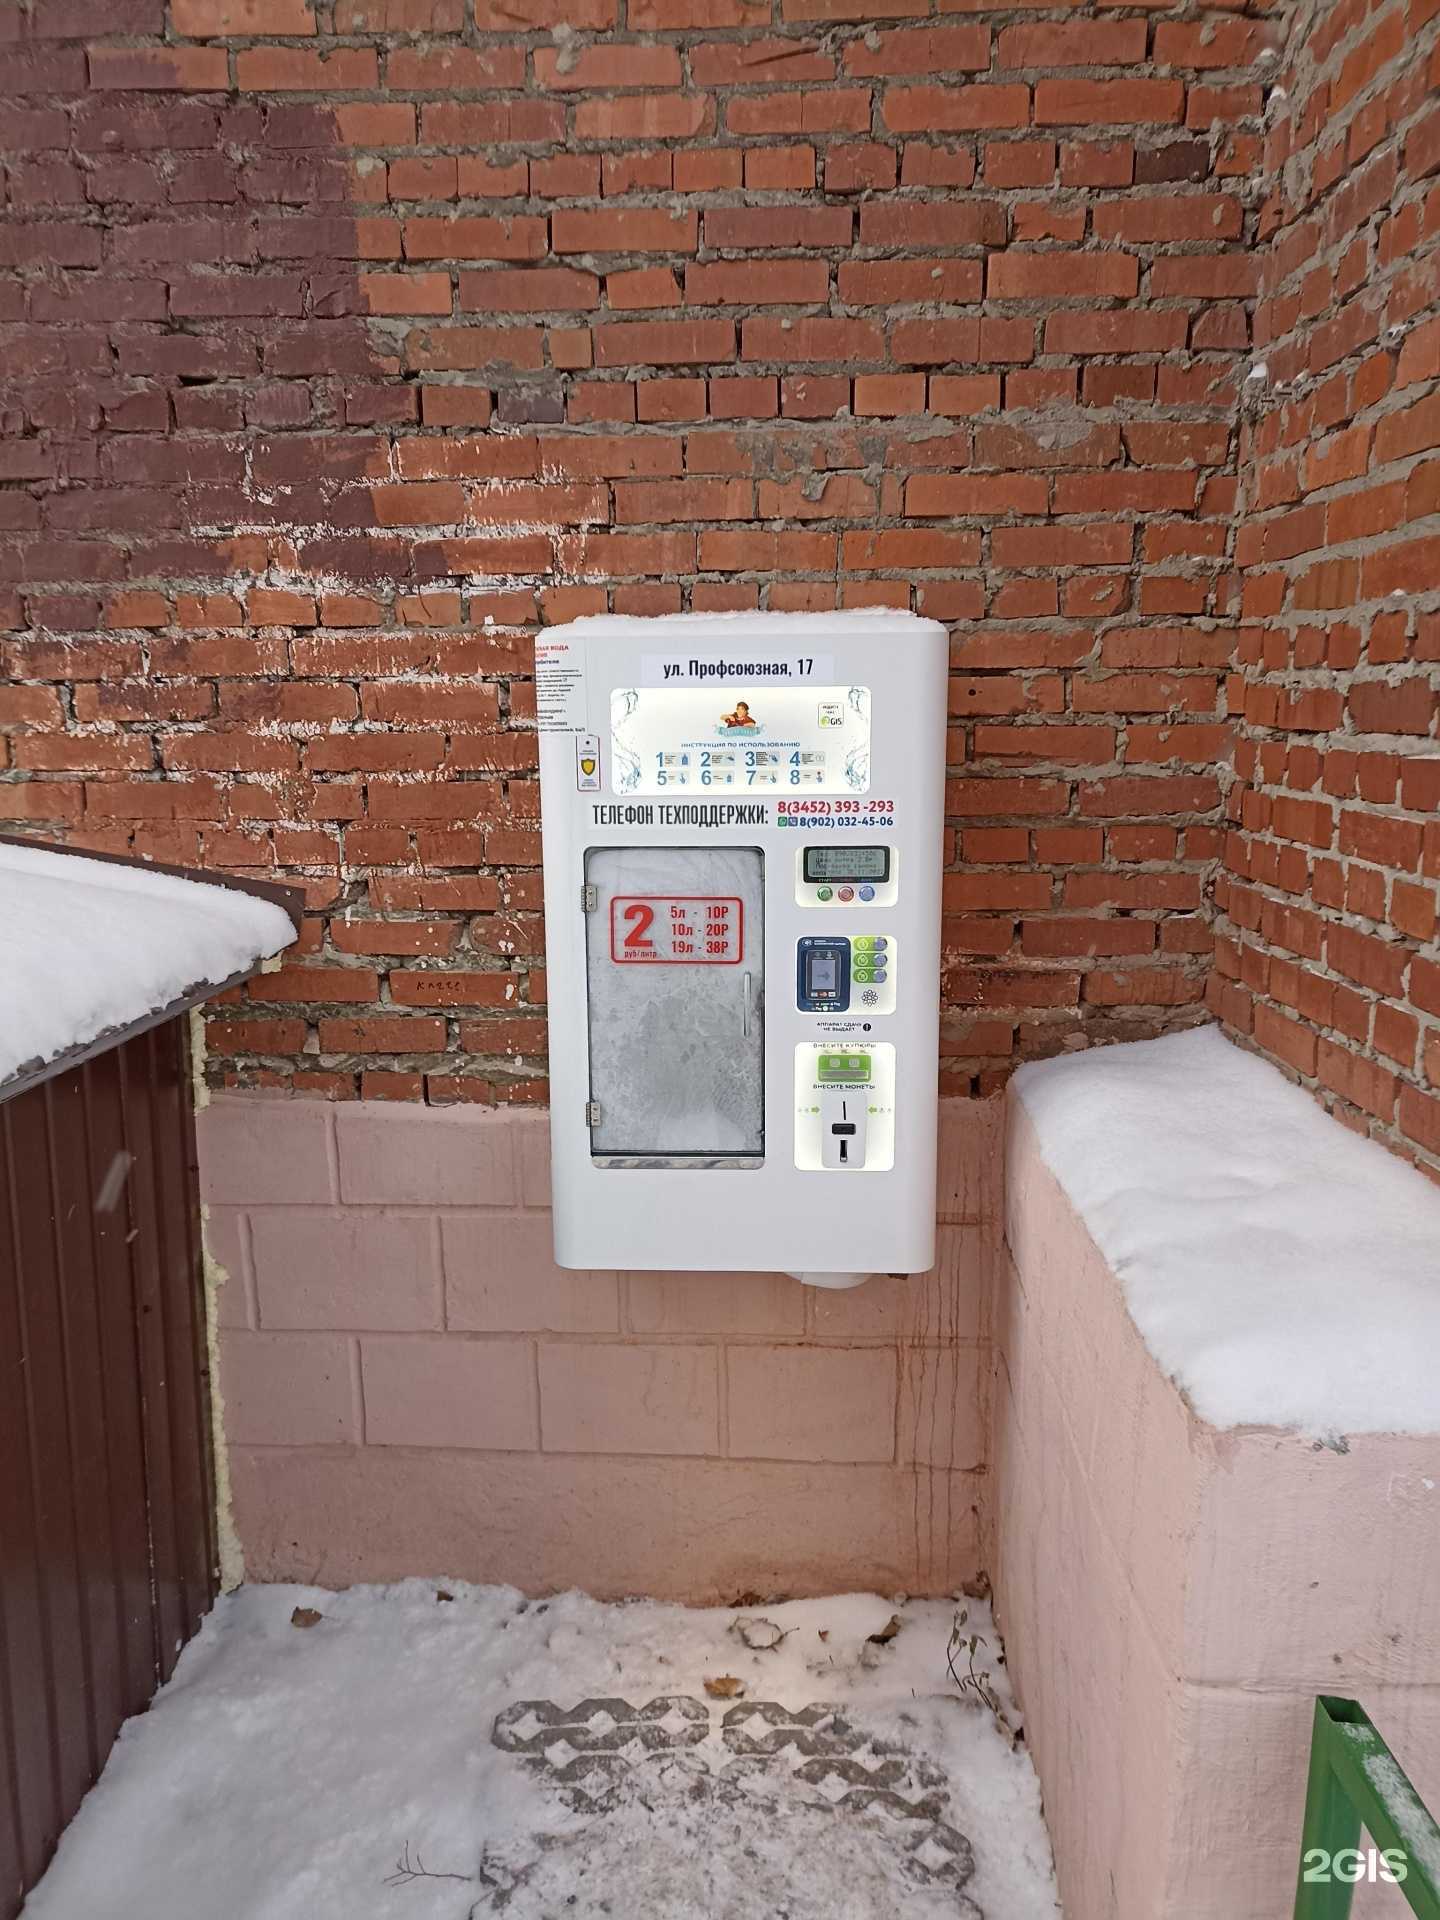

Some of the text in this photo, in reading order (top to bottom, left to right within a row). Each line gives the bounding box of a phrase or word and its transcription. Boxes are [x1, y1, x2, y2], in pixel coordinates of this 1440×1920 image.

[663, 659, 813, 679] ул. Профсоюзная, 17
[656, 752, 664, 767] 1
[700, 752, 711, 767] 2
[745, 751, 755, 767] 3
[789, 751, 800, 766] 4
[657, 770, 667, 785] 5
[701, 770, 711, 785] 6
[746, 770, 756, 785] 7
[790, 769, 800, 785] 8
[778, 800, 894, 815] 8(3452) 393 -293
[592, 804, 768, 828] ТЕЛЕФОН ТЕХПОДДЕРЖКИ:
[799, 816, 893, 828] 8(902) 032-45-06
[671, 906, 686, 918] 5л
[707, 906, 728, 918] 10Р
[624, 904, 654, 947] 2
[671, 924, 693, 936] 10л
[706, 924, 729, 936] 20Р
[671, 941, 693, 953] 19л
[706, 941, 729, 953] 38Р
